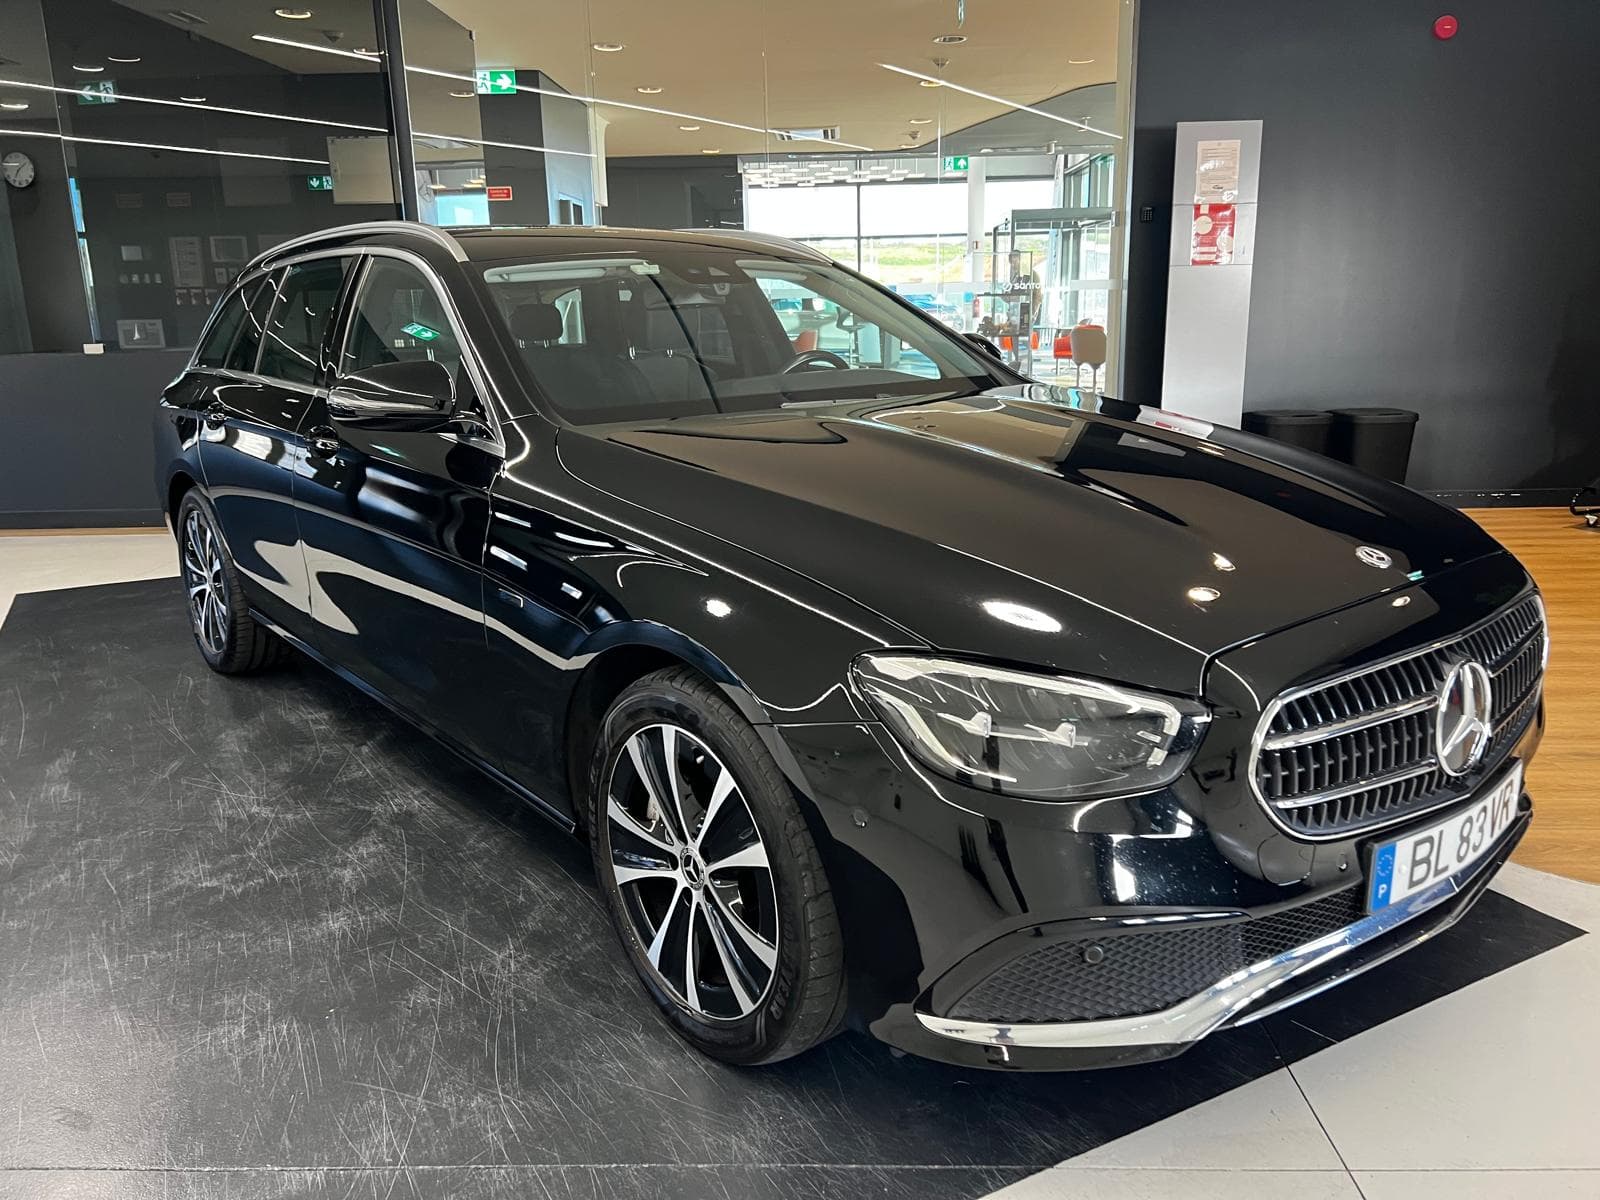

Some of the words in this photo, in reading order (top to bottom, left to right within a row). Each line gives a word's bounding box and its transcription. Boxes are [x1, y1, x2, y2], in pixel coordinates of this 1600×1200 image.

[1407, 829, 1449, 890] BL
[1456, 805, 1487, 864] 83
[1489, 779, 1514, 839] VR
[1378, 884, 1388, 899] P
